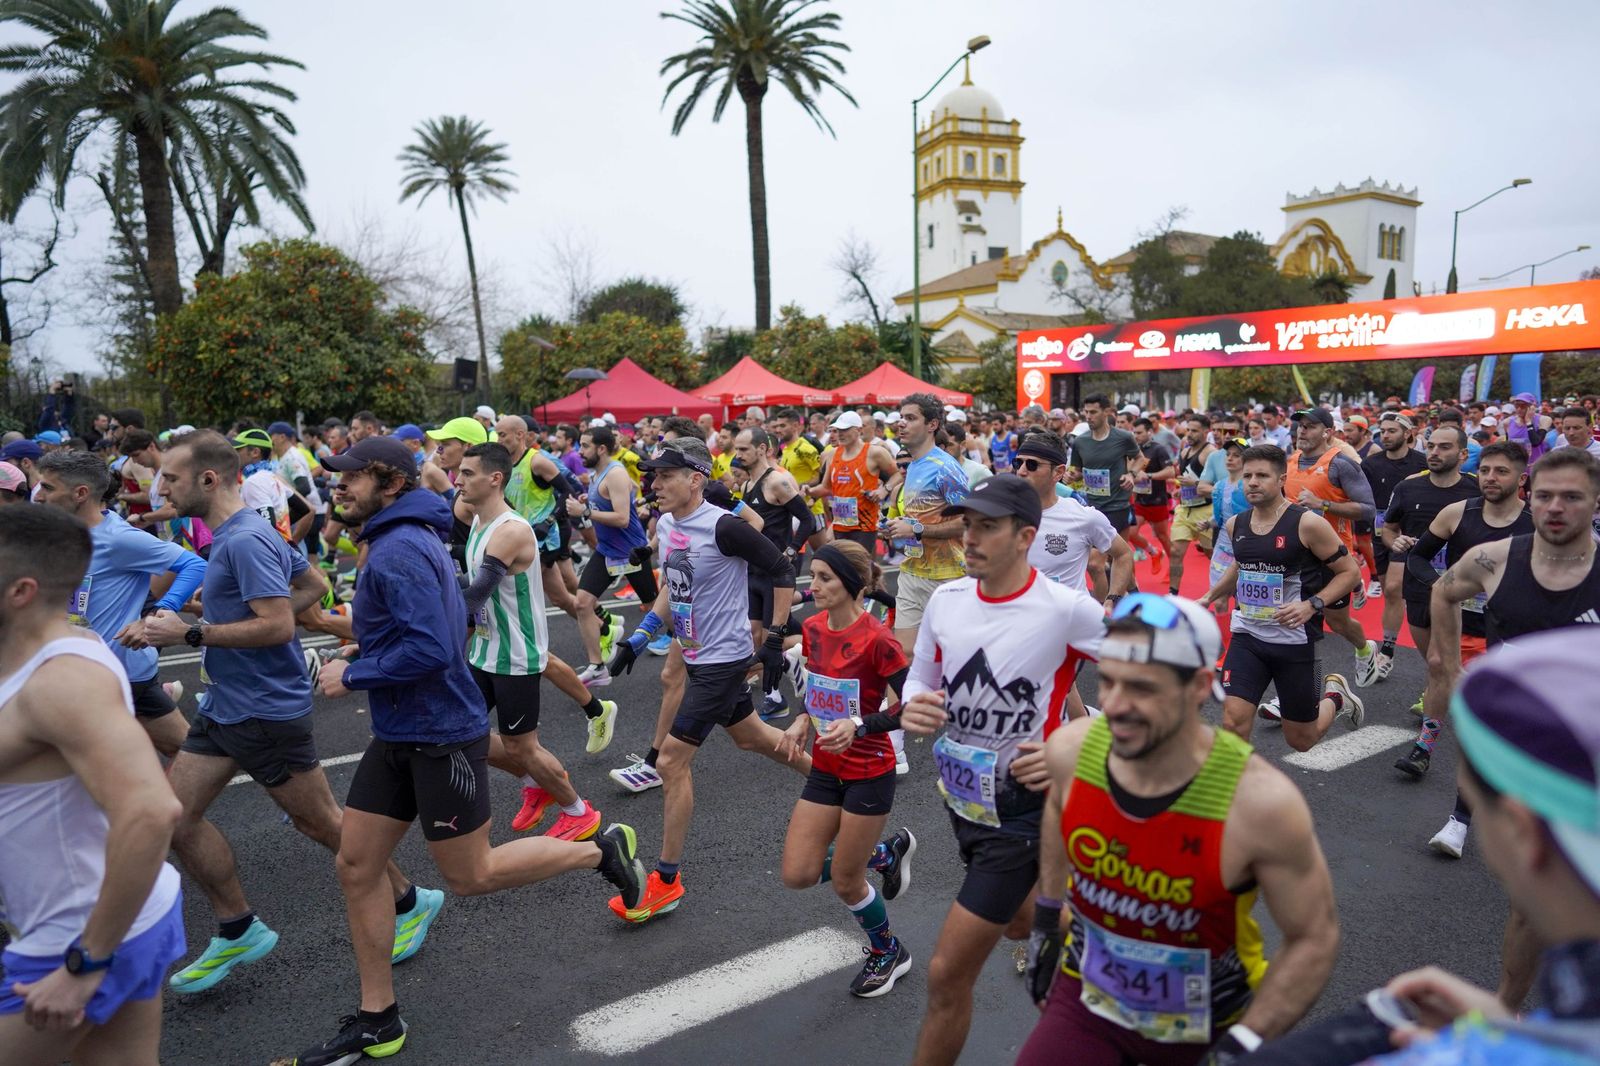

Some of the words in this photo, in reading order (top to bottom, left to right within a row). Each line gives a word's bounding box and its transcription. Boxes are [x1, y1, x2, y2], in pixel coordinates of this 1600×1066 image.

[1299, 312, 1386, 335] maratón
[1504, 303, 1588, 330] HOKA
[1317, 328, 1386, 349] sevilla
[1241, 582, 1269, 600] 1958
[810, 688, 845, 713] 2645
[1068, 826, 1195, 905] Gorras
[1071, 870, 1202, 931] unners
